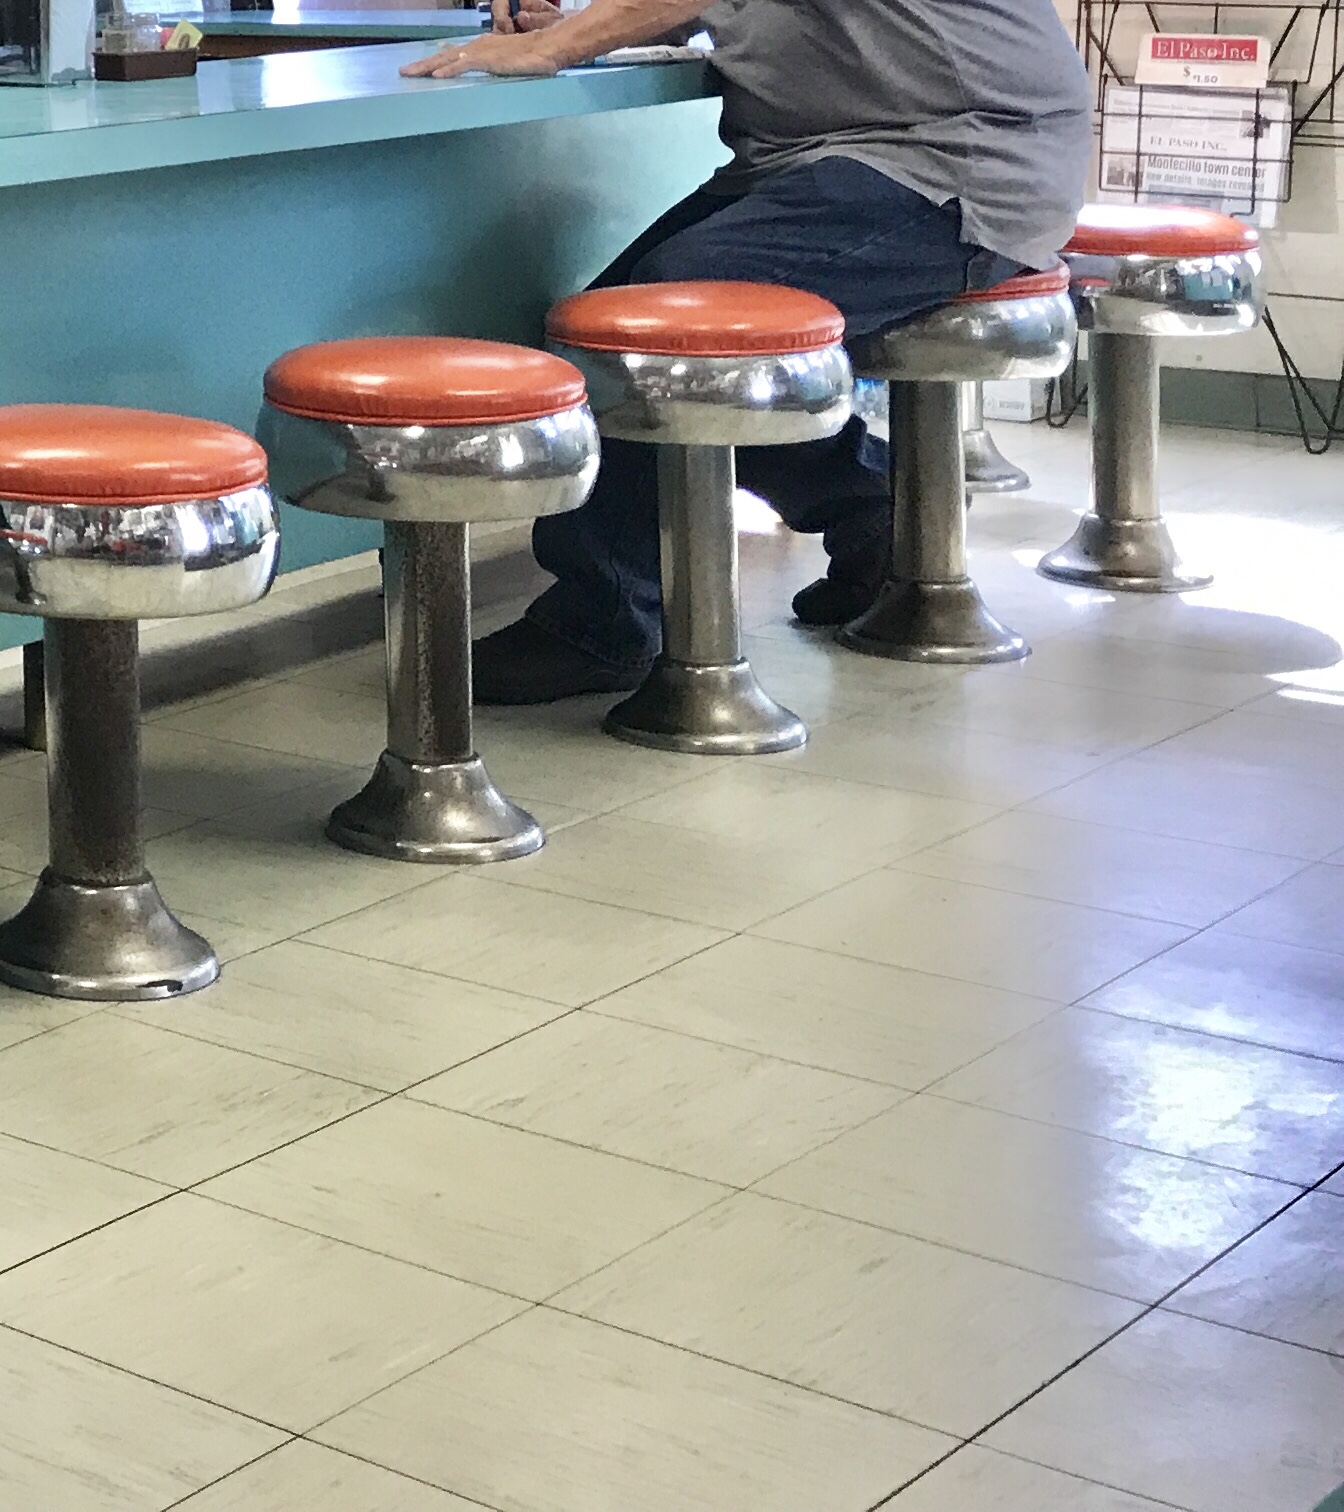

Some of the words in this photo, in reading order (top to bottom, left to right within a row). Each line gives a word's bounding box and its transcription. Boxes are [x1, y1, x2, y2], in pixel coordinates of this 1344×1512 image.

[1156, 40, 1175, 58] El
[1179, 41, 1219, 59] Paso
[1221, 42, 1256, 60] Inc.
[1149, 135, 1162, 146] EL
[1168, 136, 1199, 149] PASO
[1147, 154, 1202, 174] Montecillo
[1203, 161, 1230, 176] town
[1231, 163, 1266, 180] cener
